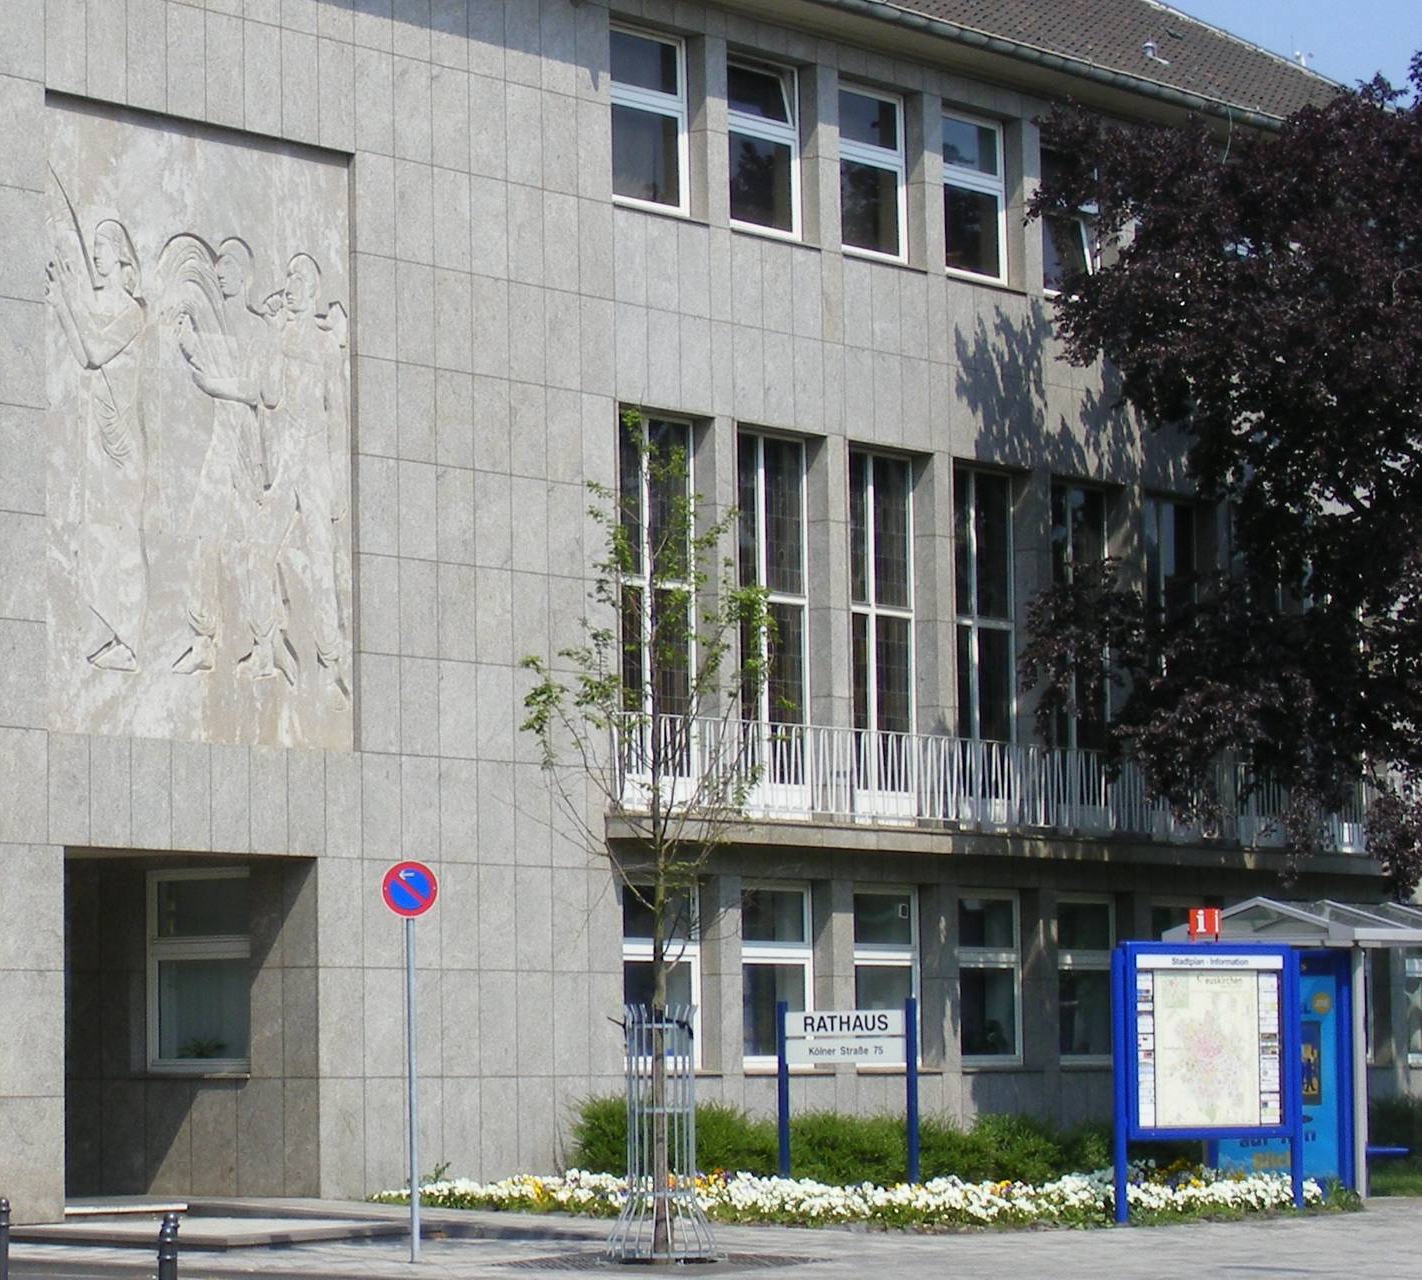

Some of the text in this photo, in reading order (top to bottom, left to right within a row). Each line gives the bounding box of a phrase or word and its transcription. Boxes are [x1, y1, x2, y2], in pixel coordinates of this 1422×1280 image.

[1196, 909, 1207, 933] i
[1171, 957, 1205, 967] Stadtplan
[1210, 957, 1249, 966] Information
[803, 1014, 889, 1032] RATHAUS
[808, 1045, 884, 1056] Kölner Straße 75
